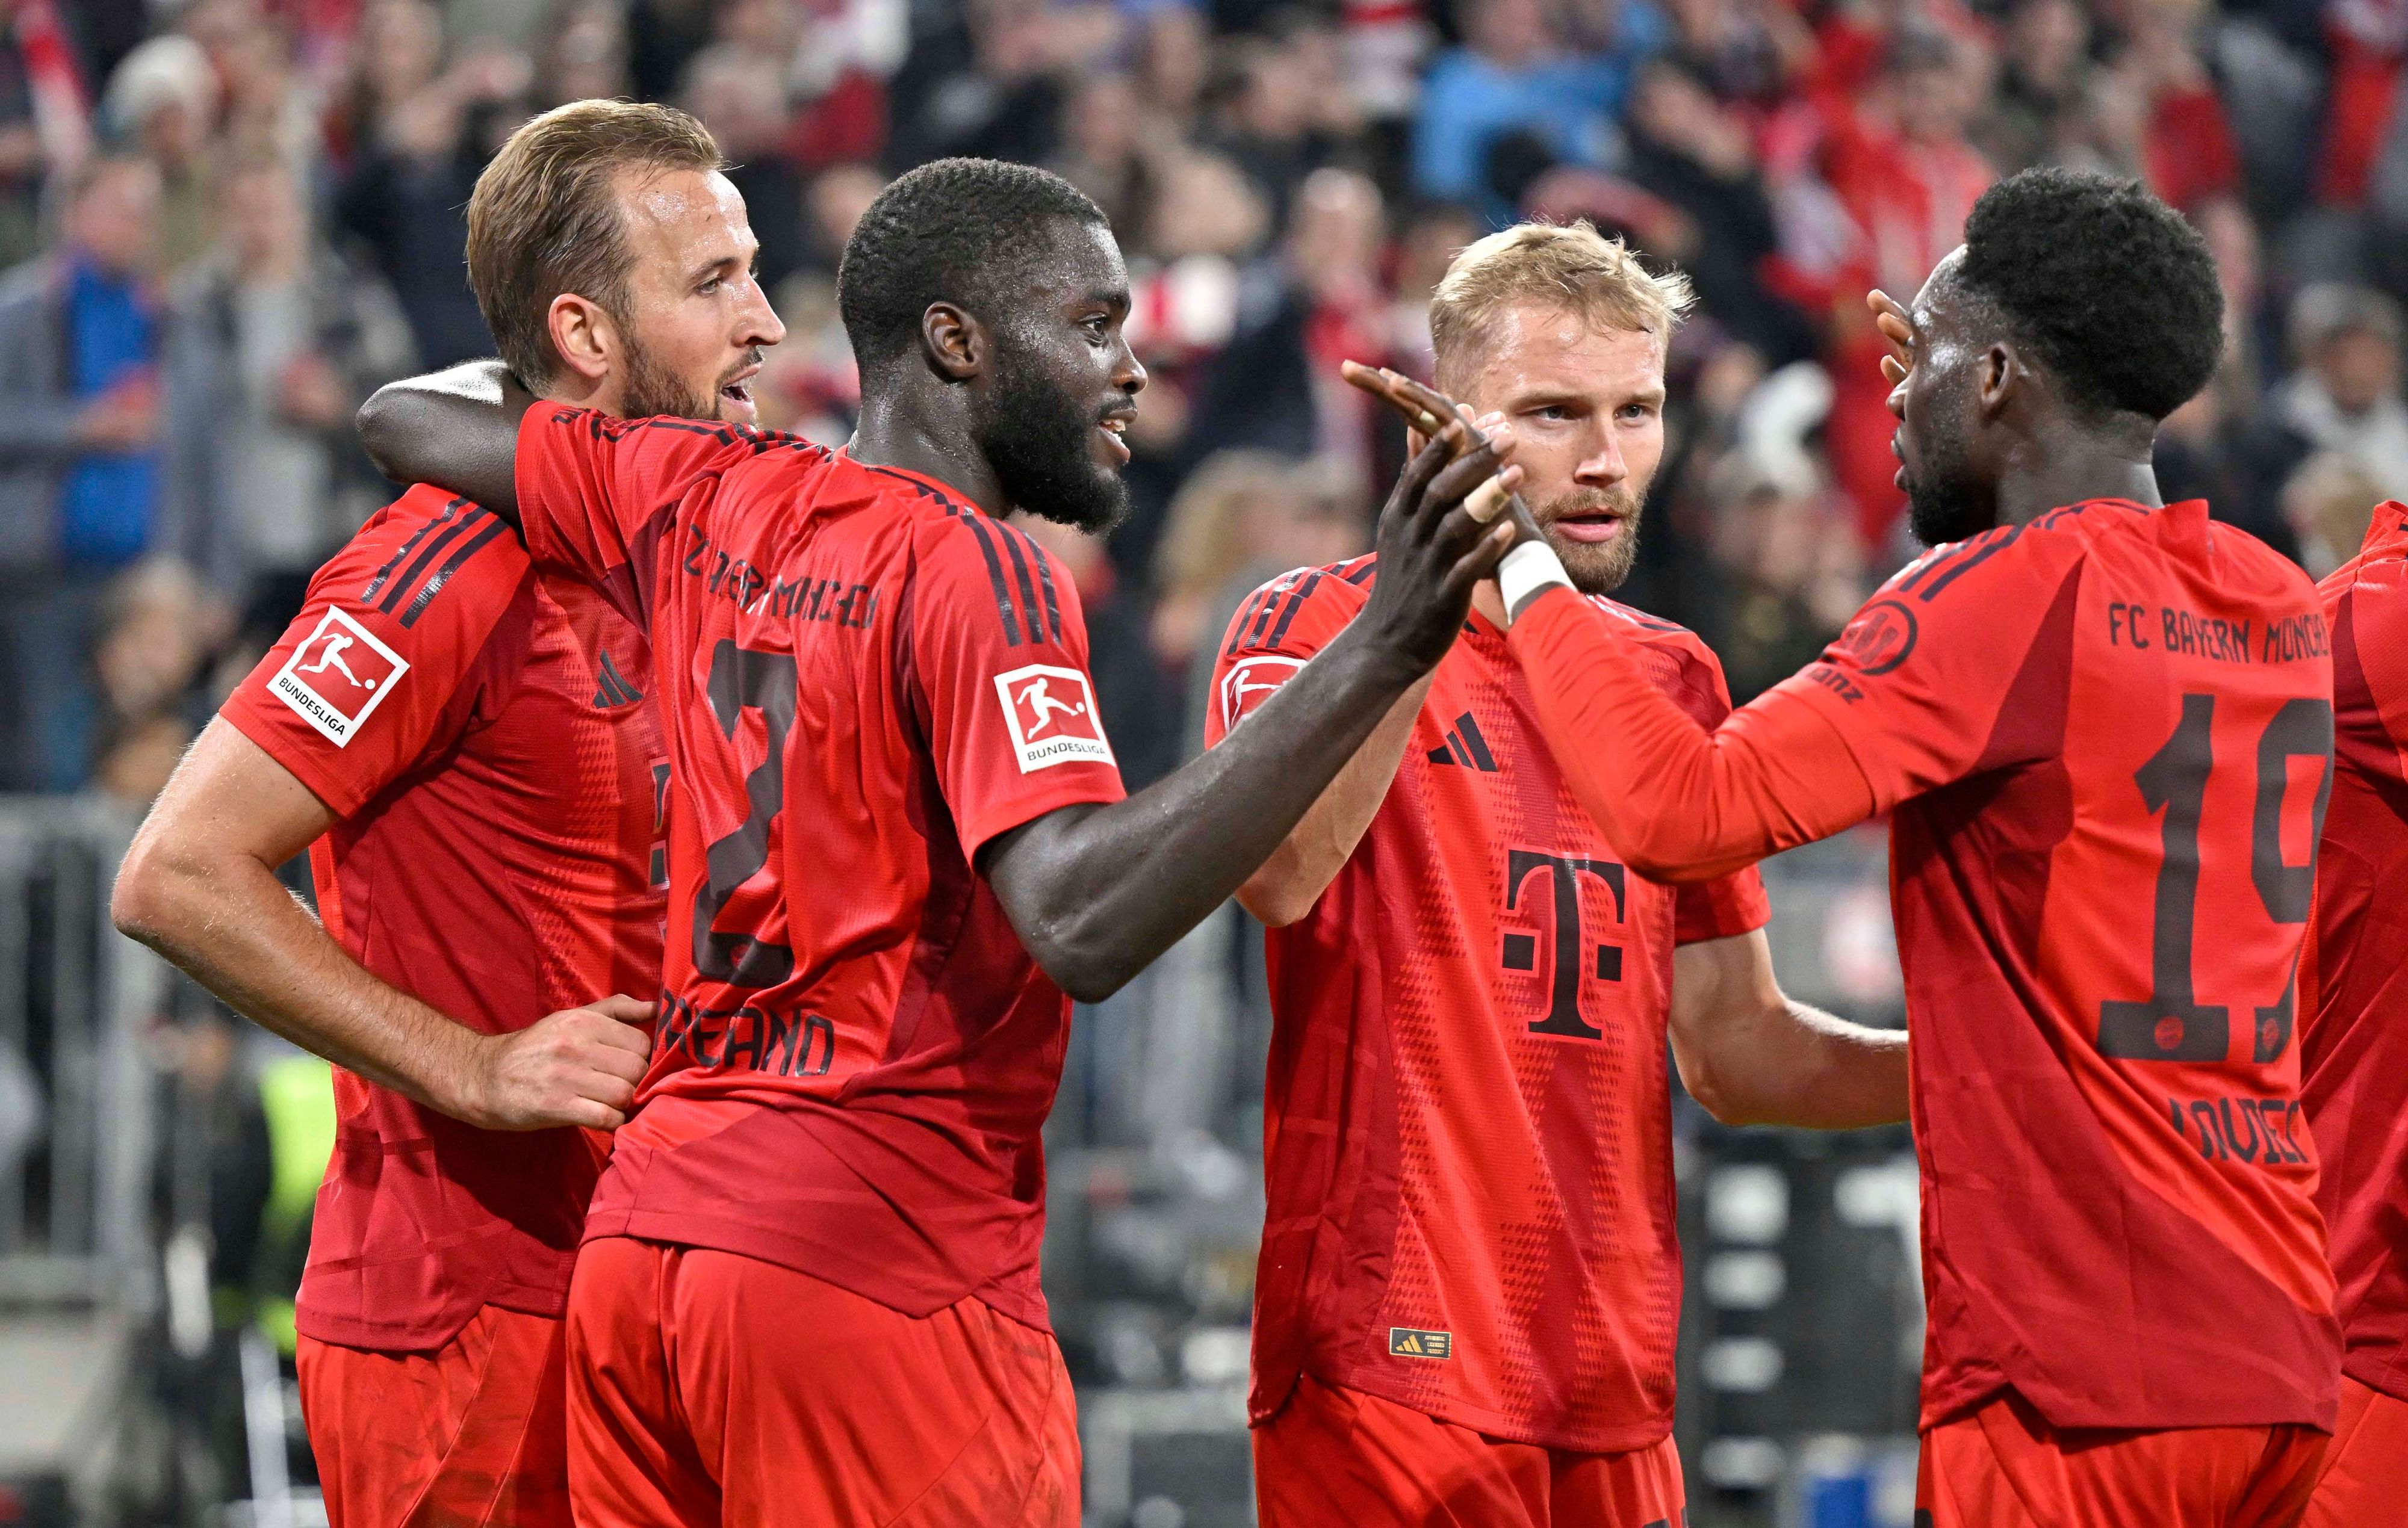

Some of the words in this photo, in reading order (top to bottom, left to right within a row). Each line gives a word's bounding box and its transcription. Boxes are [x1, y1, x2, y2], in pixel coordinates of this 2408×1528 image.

[2109, 602, 2150, 649] FC
[2161, 607, 2250, 664] BAYERN
[279, 678, 346, 735] BUNDESLIGA
[1027, 742, 1106, 761] BUNDESLIGA
[692, 638, 799, 989] 2
[2097, 693, 2335, 1063] 19
[1503, 849, 1625, 1042] T
